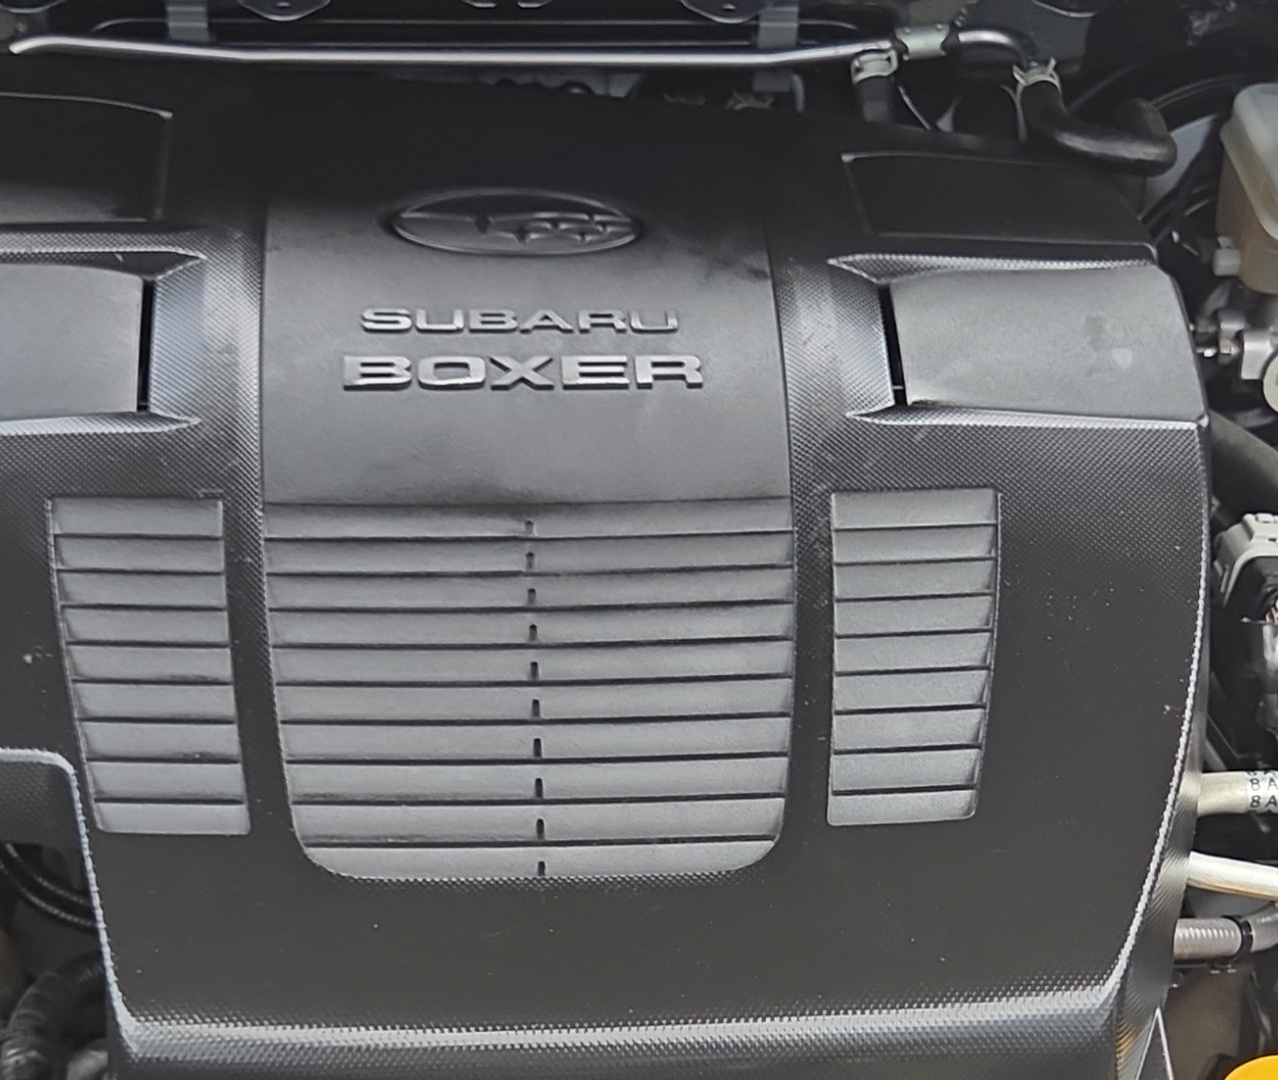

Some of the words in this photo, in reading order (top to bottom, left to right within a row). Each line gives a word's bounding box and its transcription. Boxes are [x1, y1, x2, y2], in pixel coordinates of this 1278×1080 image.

[361, 308, 678, 333] SUBARU
[343, 355, 703, 390] BOXER
[1266, 777, 1278, 790] A
[1249, 794, 1261, 807] 8
[1264, 794, 1277, 807] A
